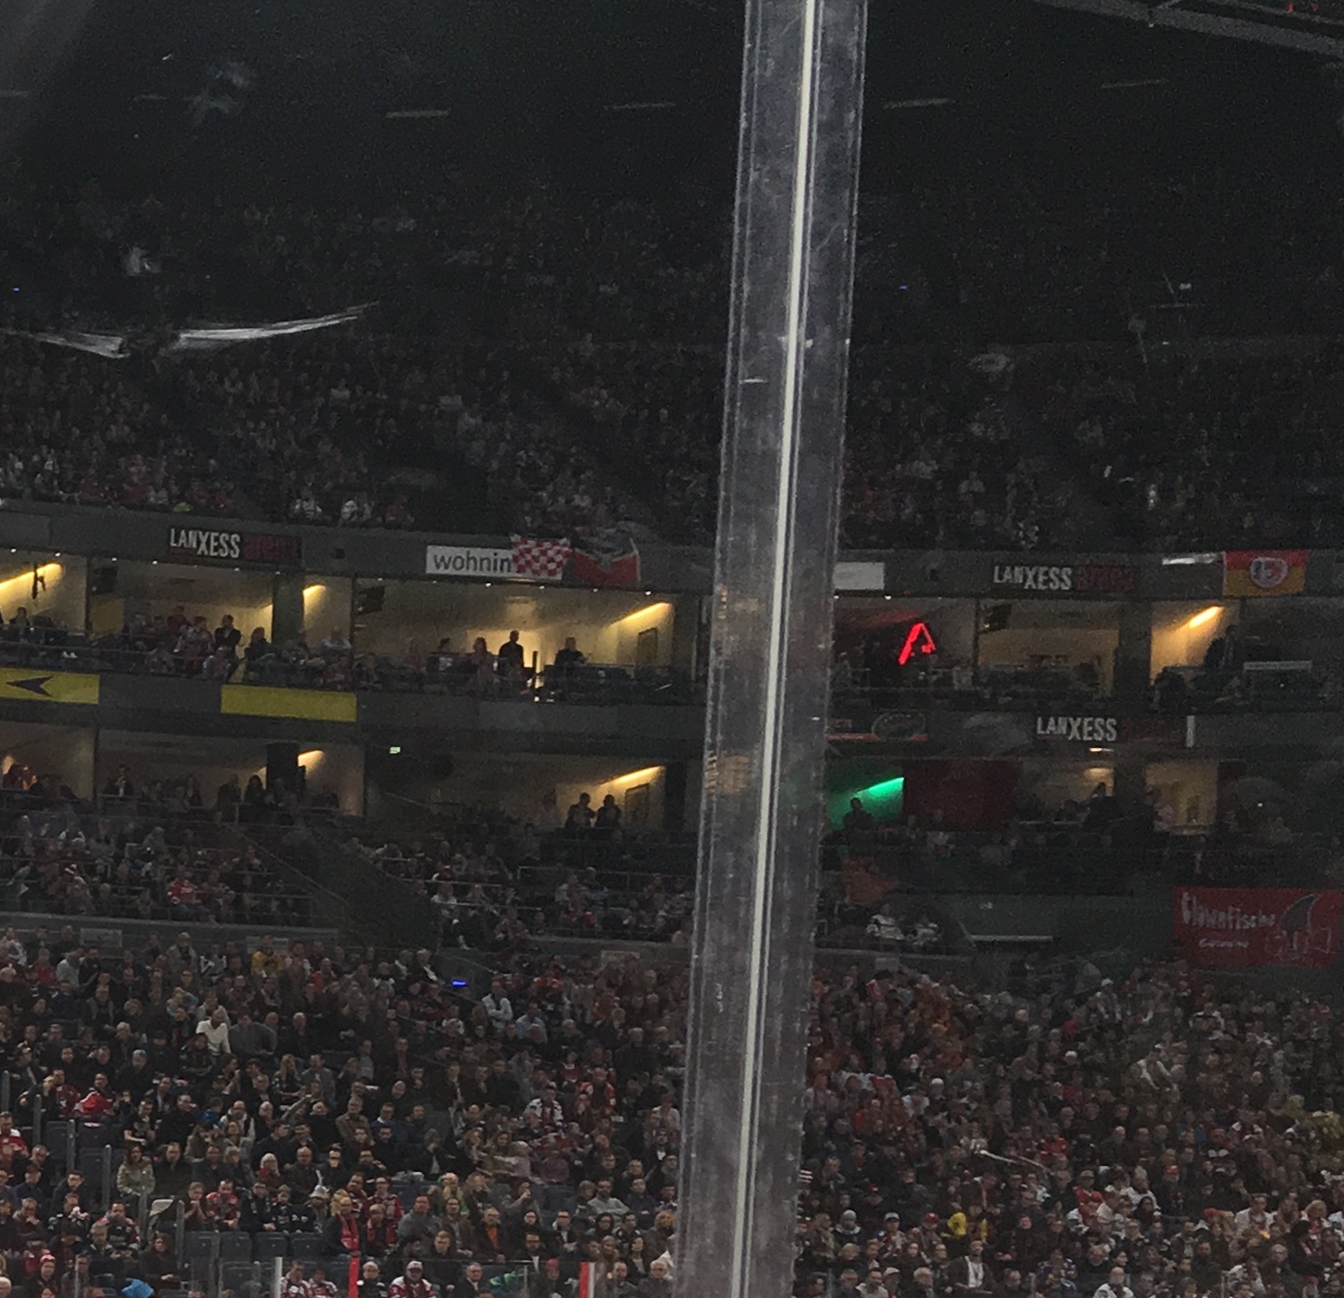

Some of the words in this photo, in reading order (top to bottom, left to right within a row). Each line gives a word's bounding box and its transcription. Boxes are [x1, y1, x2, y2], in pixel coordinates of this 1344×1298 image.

[169, 527, 242, 559] LANXESS
[432, 550, 512, 574] wohnin
[993, 564, 1074, 591] LANXESS
[1035, 716, 1118, 742] LANXESS
